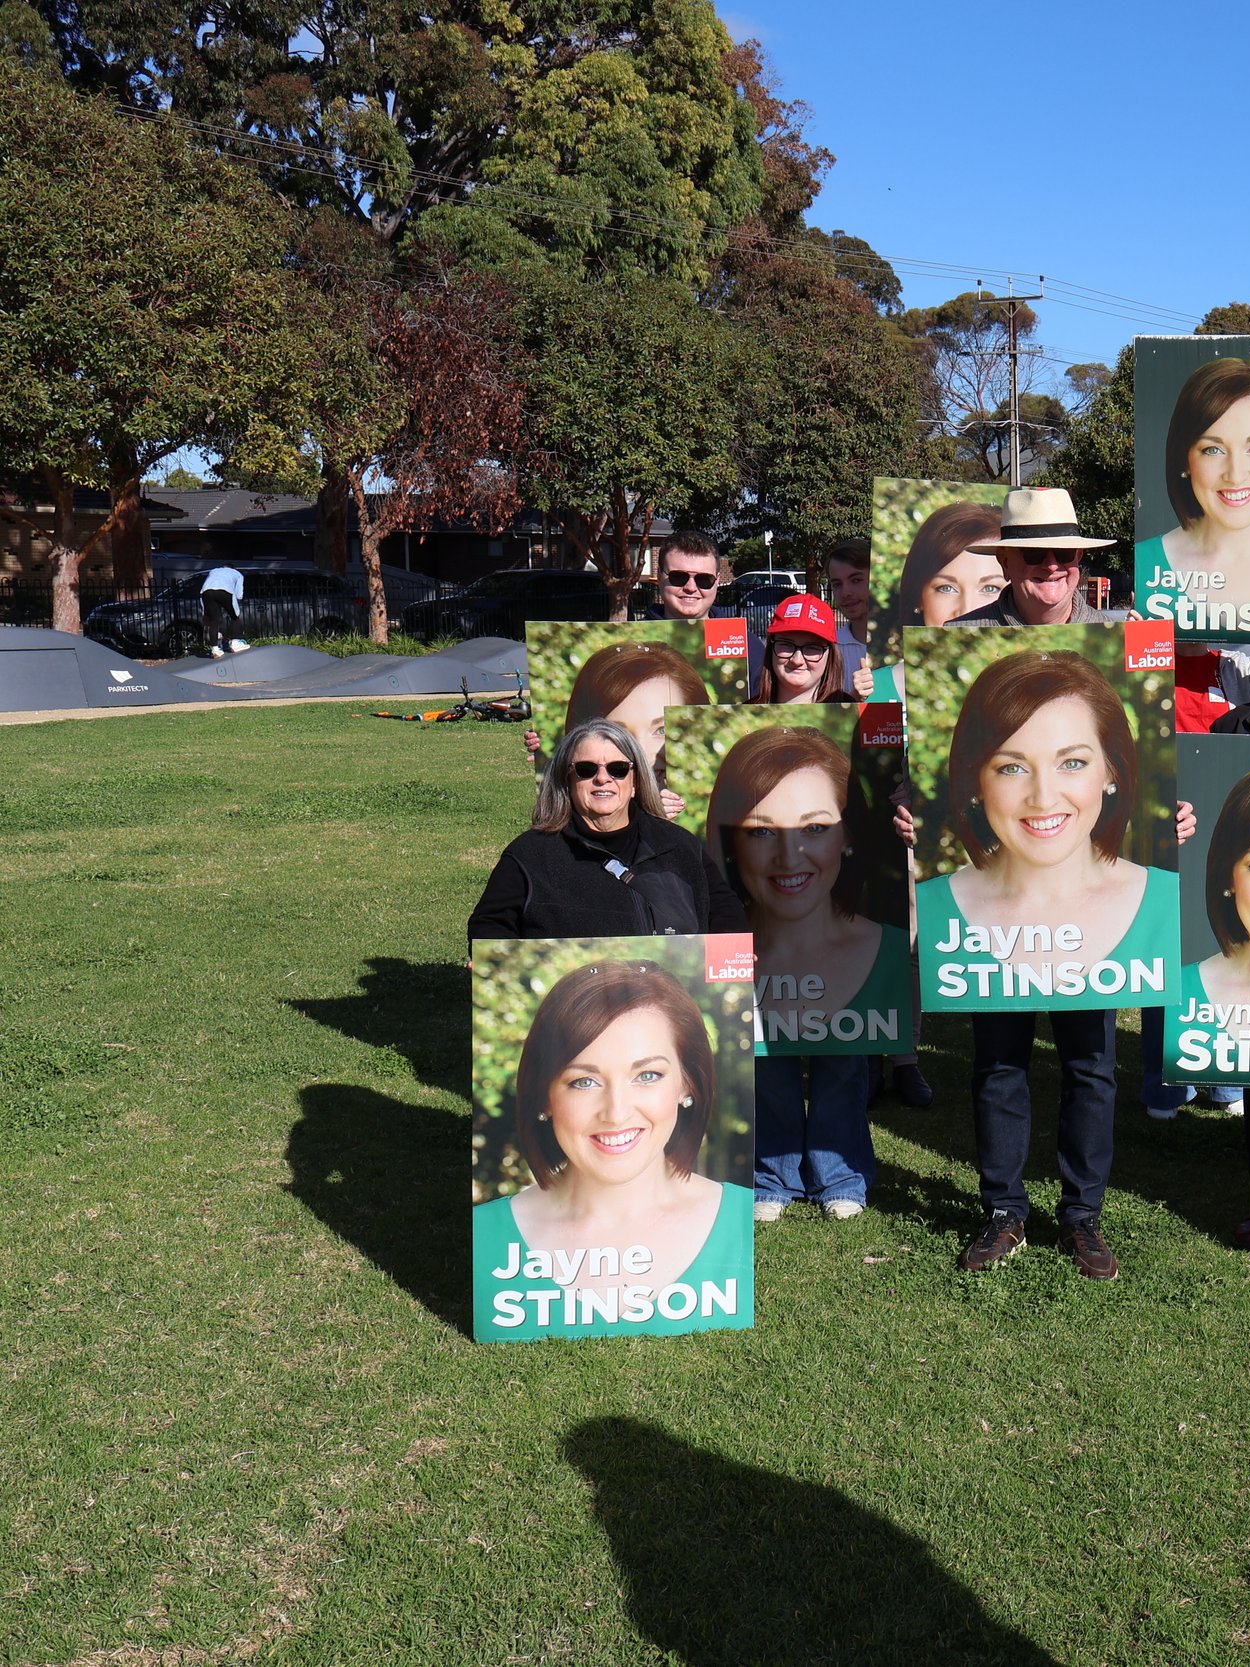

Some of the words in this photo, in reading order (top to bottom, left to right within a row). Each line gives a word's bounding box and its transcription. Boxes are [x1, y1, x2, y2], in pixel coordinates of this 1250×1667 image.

[1145, 565, 1226, 592] Jayne
[708, 645, 745, 656] Labor
[1128, 654, 1173, 668] Labor
[863, 733, 902, 744] Labor
[935, 918, 1083, 960] Jayne
[709, 965, 754, 979] Labor
[937, 957, 1165, 997] STINSON
[753, 974, 825, 1007] yne
[754, 1009, 899, 1041] INSON
[491, 1242, 653, 1285] Jayne
[491, 1278, 738, 1328] STINSON
